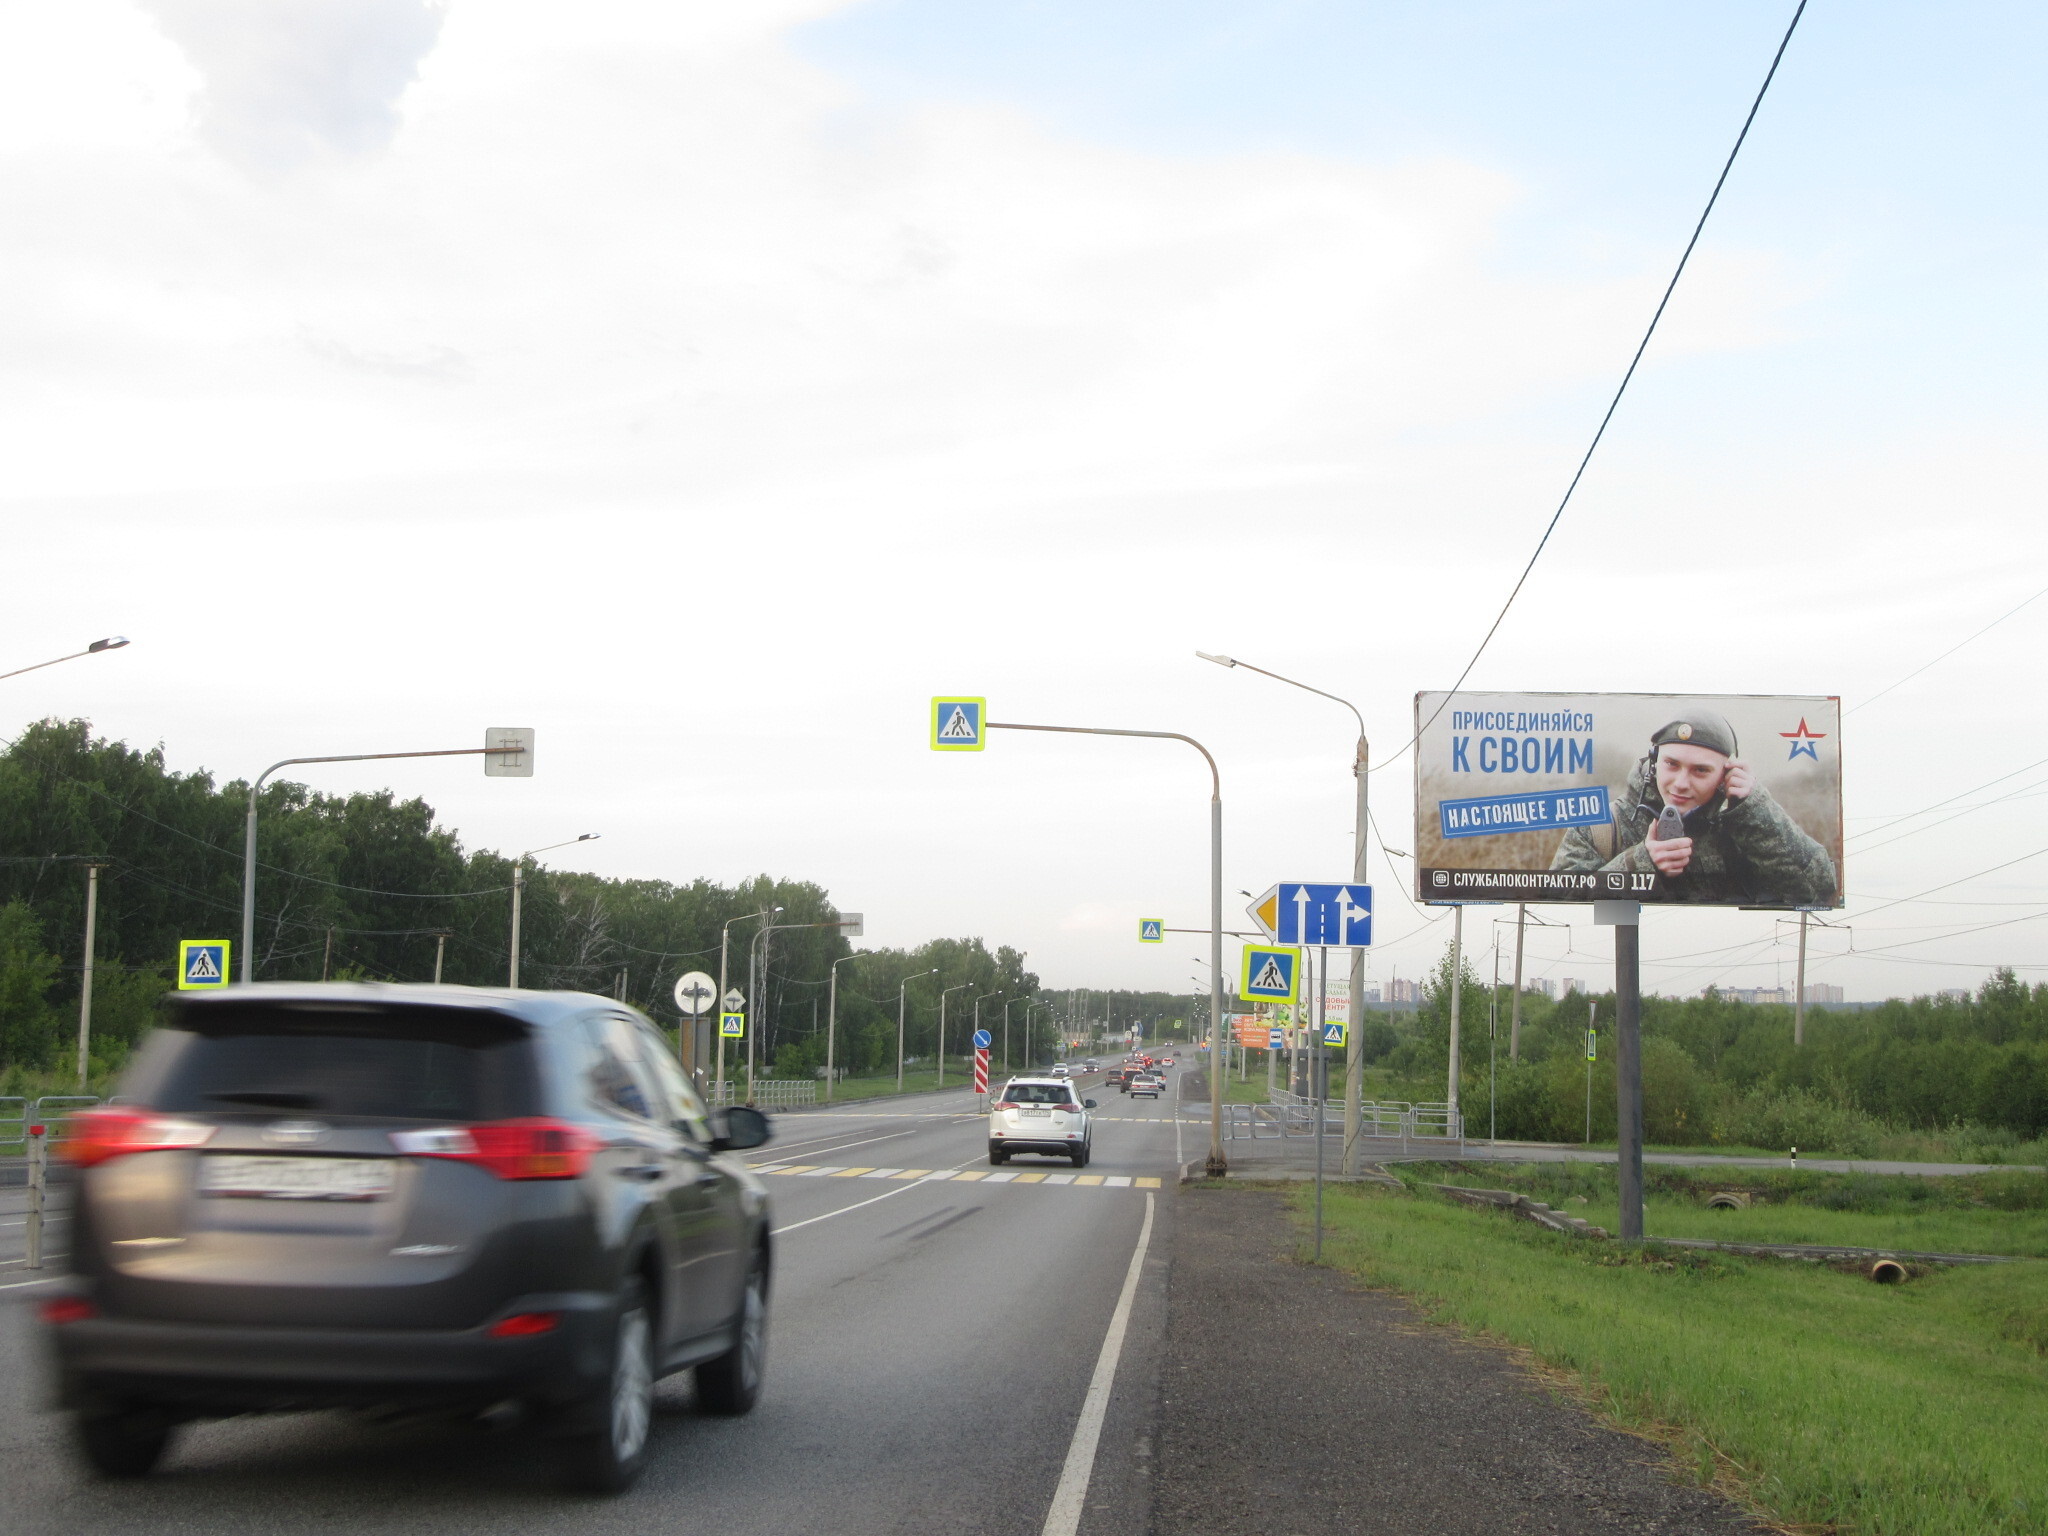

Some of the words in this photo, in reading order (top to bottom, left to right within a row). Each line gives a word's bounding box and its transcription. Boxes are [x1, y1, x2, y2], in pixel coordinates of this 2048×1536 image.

[1453, 709, 1593, 733] ПРИСОЕДИНЯЙСЯ
[1453, 736, 1471, 773] К
[1480, 736, 1593, 774] СВОИМ
[1448, 801, 1547, 828] НАСТОЯЩЕЕ
[1556, 796, 1600, 821] ДЕЛО
[1454, 873, 1597, 889] СЛУЖБАПОКОНТРАКТУ.РФ
[1631, 873, 1656, 891] 117
